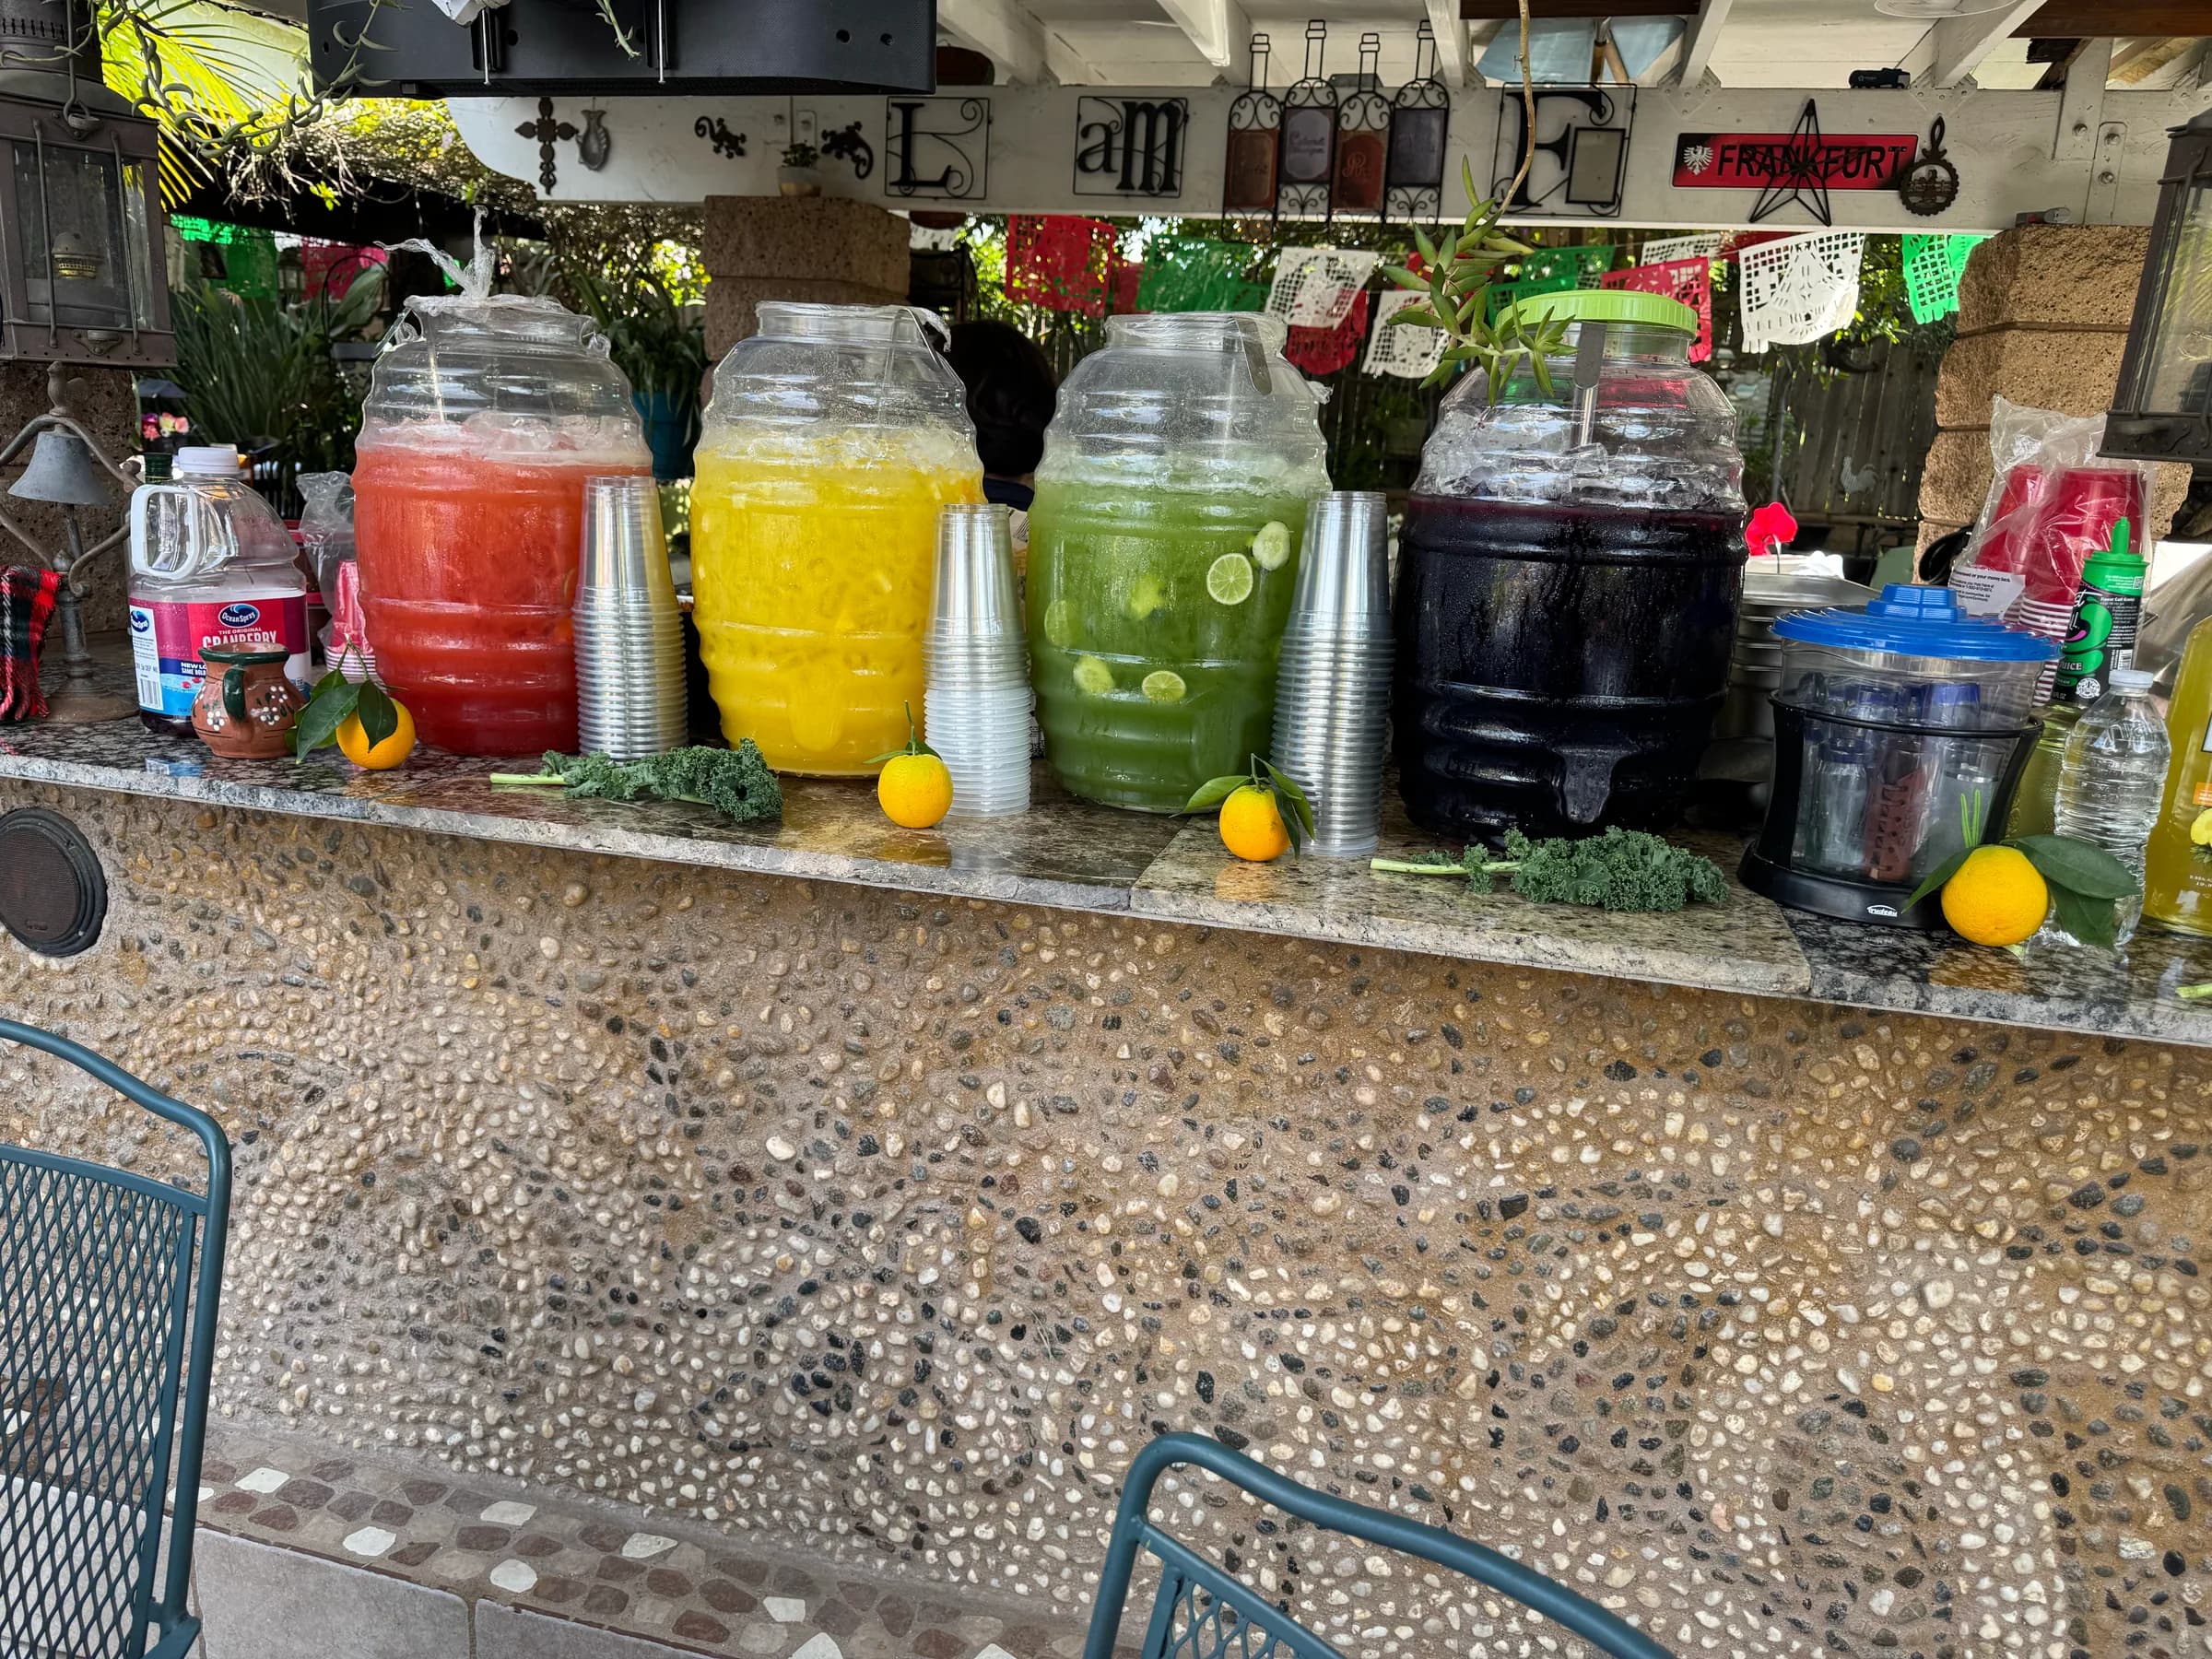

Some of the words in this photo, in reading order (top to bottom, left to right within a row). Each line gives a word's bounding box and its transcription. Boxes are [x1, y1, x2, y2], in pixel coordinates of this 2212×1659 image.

[889, 102, 952, 186] L
[1717, 144, 1907, 180] FRANKFURT
[221, 612, 240, 623] Ocean
[239, 611, 255, 624] Spray
[181, 661, 198, 669] NEW
